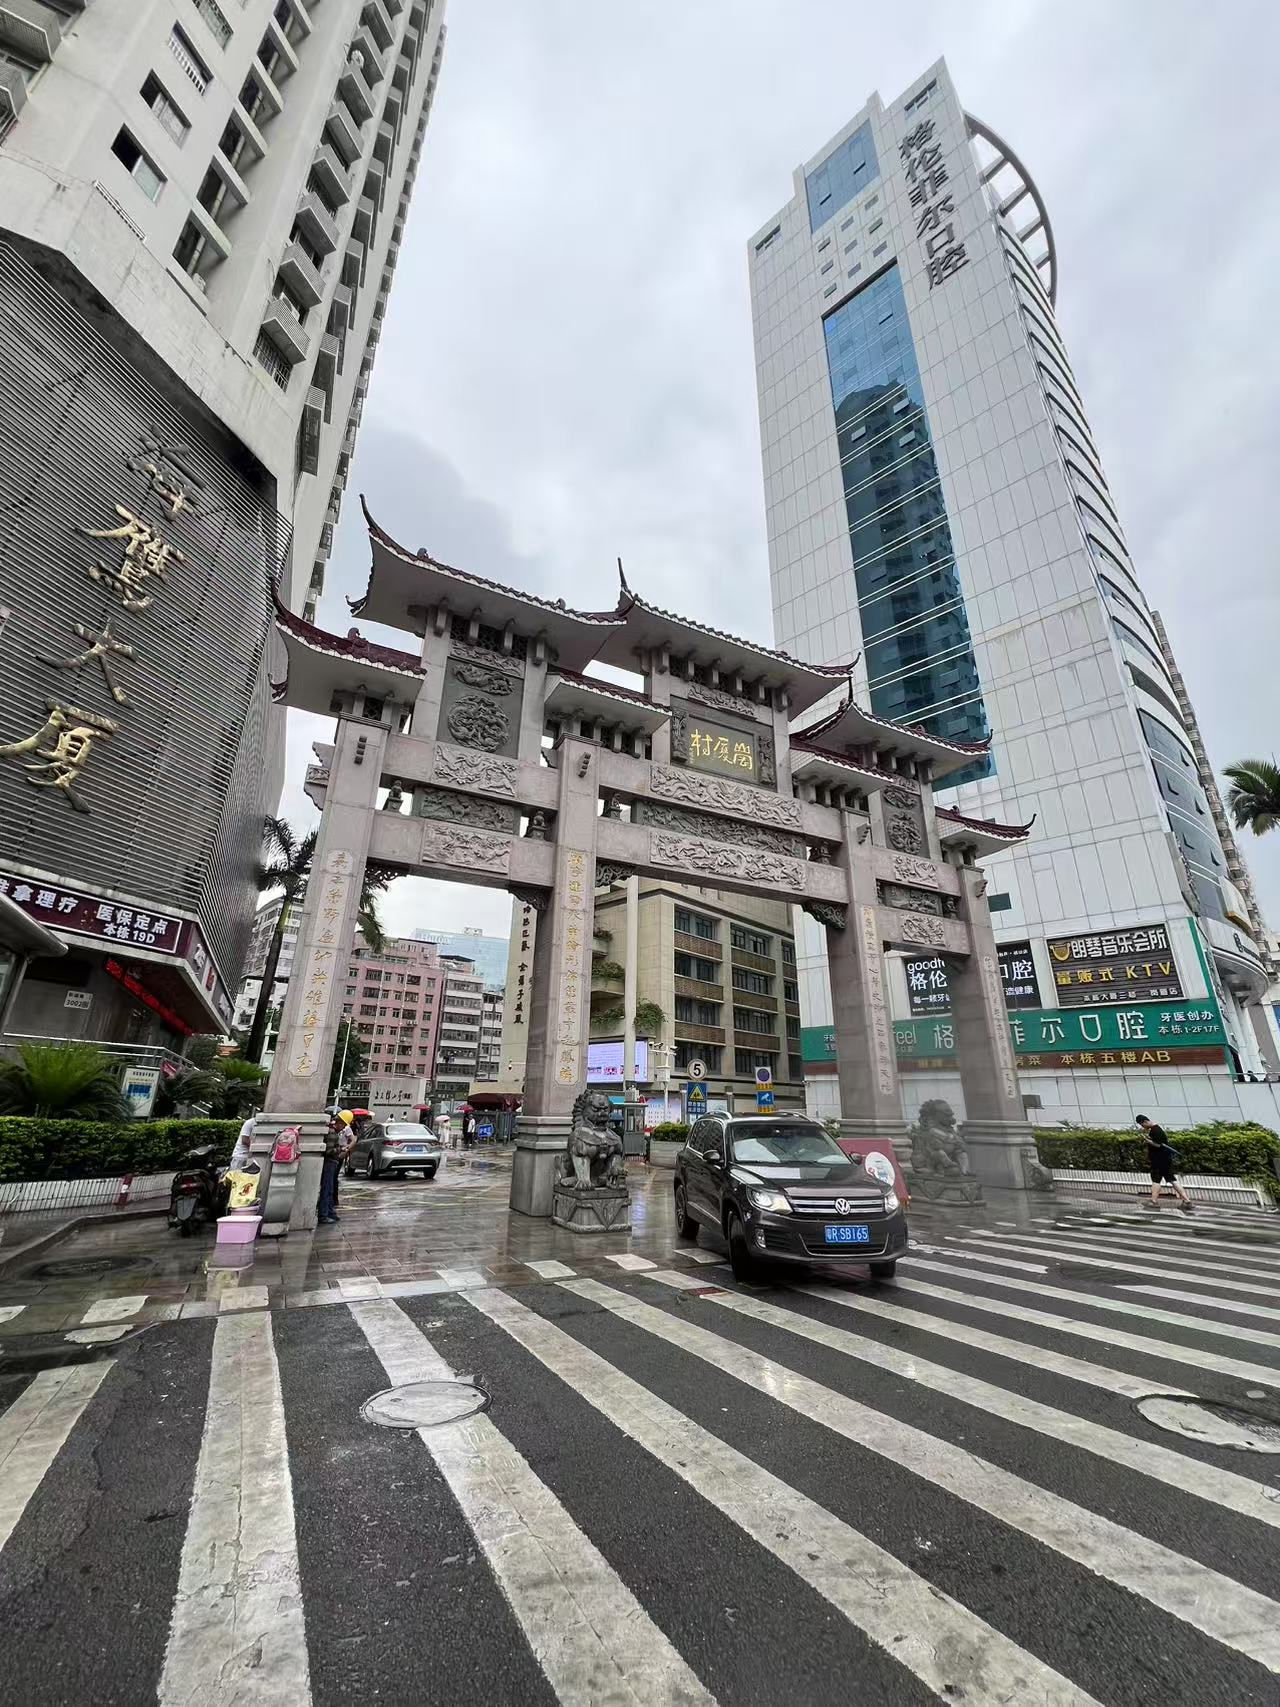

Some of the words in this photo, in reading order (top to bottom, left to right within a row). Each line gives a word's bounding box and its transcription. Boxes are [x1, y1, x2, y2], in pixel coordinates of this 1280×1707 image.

[899, 119, 970, 291] 格伦菲尔口腔
[96, 904, 169, 936] 医保定点
[1071, 929, 1168, 959] 朗琴音乐会所
[910, 970, 948, 990] 格伦
[1056, 967, 1116, 985] 量贩式
[1125, 961, 1171, 979] KTV
[1003, 985, 1035, 996] 造健康
[1159, 1010, 1215, 1022] 牙医创办
[1060, 1050, 1172, 1065] 本栋五楼AB
[693, 1063, 701, 1076] 5
